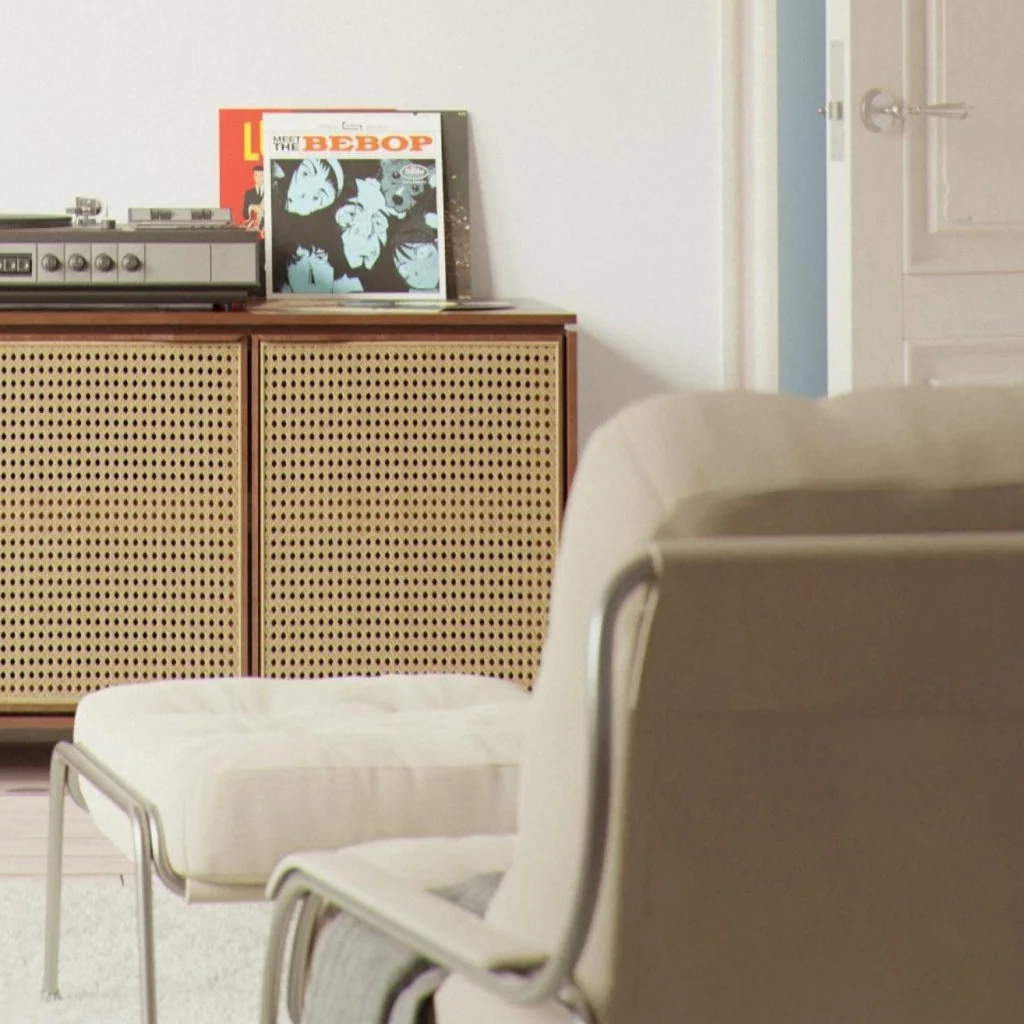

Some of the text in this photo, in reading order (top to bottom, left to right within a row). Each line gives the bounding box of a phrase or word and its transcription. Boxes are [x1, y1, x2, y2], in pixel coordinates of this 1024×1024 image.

[272, 135, 301, 143] MEET
[302, 134, 434, 153] BEBOP
[274, 142, 300, 152] THE
